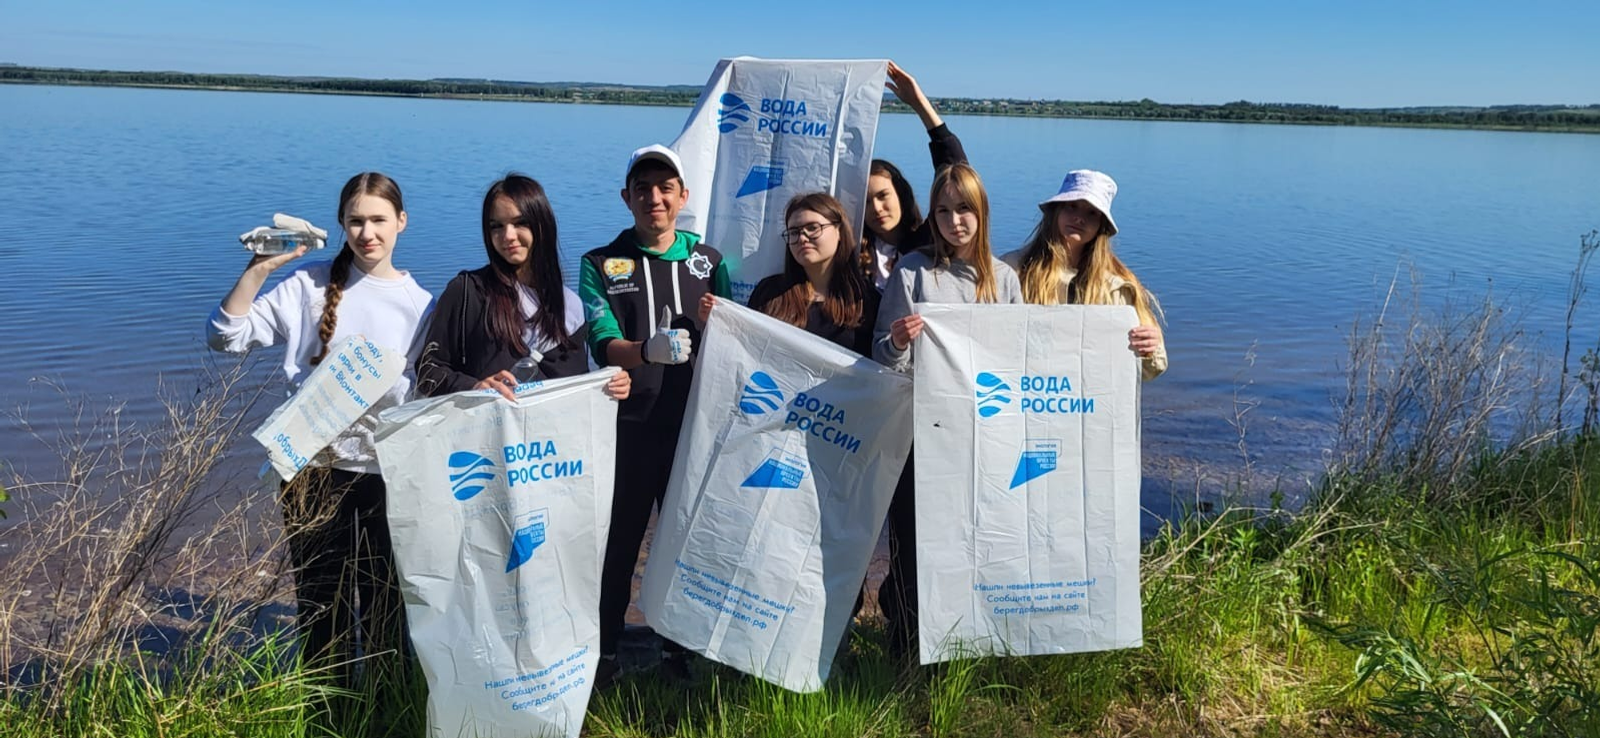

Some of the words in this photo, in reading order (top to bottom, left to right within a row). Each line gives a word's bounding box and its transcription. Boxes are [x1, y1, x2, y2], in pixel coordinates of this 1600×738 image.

[761, 99, 807, 117] ВОДА
[758, 118, 828, 137] РОССИИ
[353, 346, 382, 379] бонусы
[364, 340, 384, 363] оду,
[1020, 376, 1071, 394] ВОДА
[793, 392, 846, 424] ВОДА
[1021, 398, 1094, 413] РОССИИ
[784, 411, 861, 454] РОССИИ
[503, 440, 557, 463] ВОДА
[507, 459, 583, 487] РОССИИ
[681, 573, 722, 597] Сообщите
[742, 601, 753, 611] на
[755, 605, 778, 621] сайте
[987, 591, 1032, 603] Сообщите
[1064, 590, 1085, 600] сайте
[501, 683, 547, 700] Сообщите
[567, 662, 585, 677] сайте
